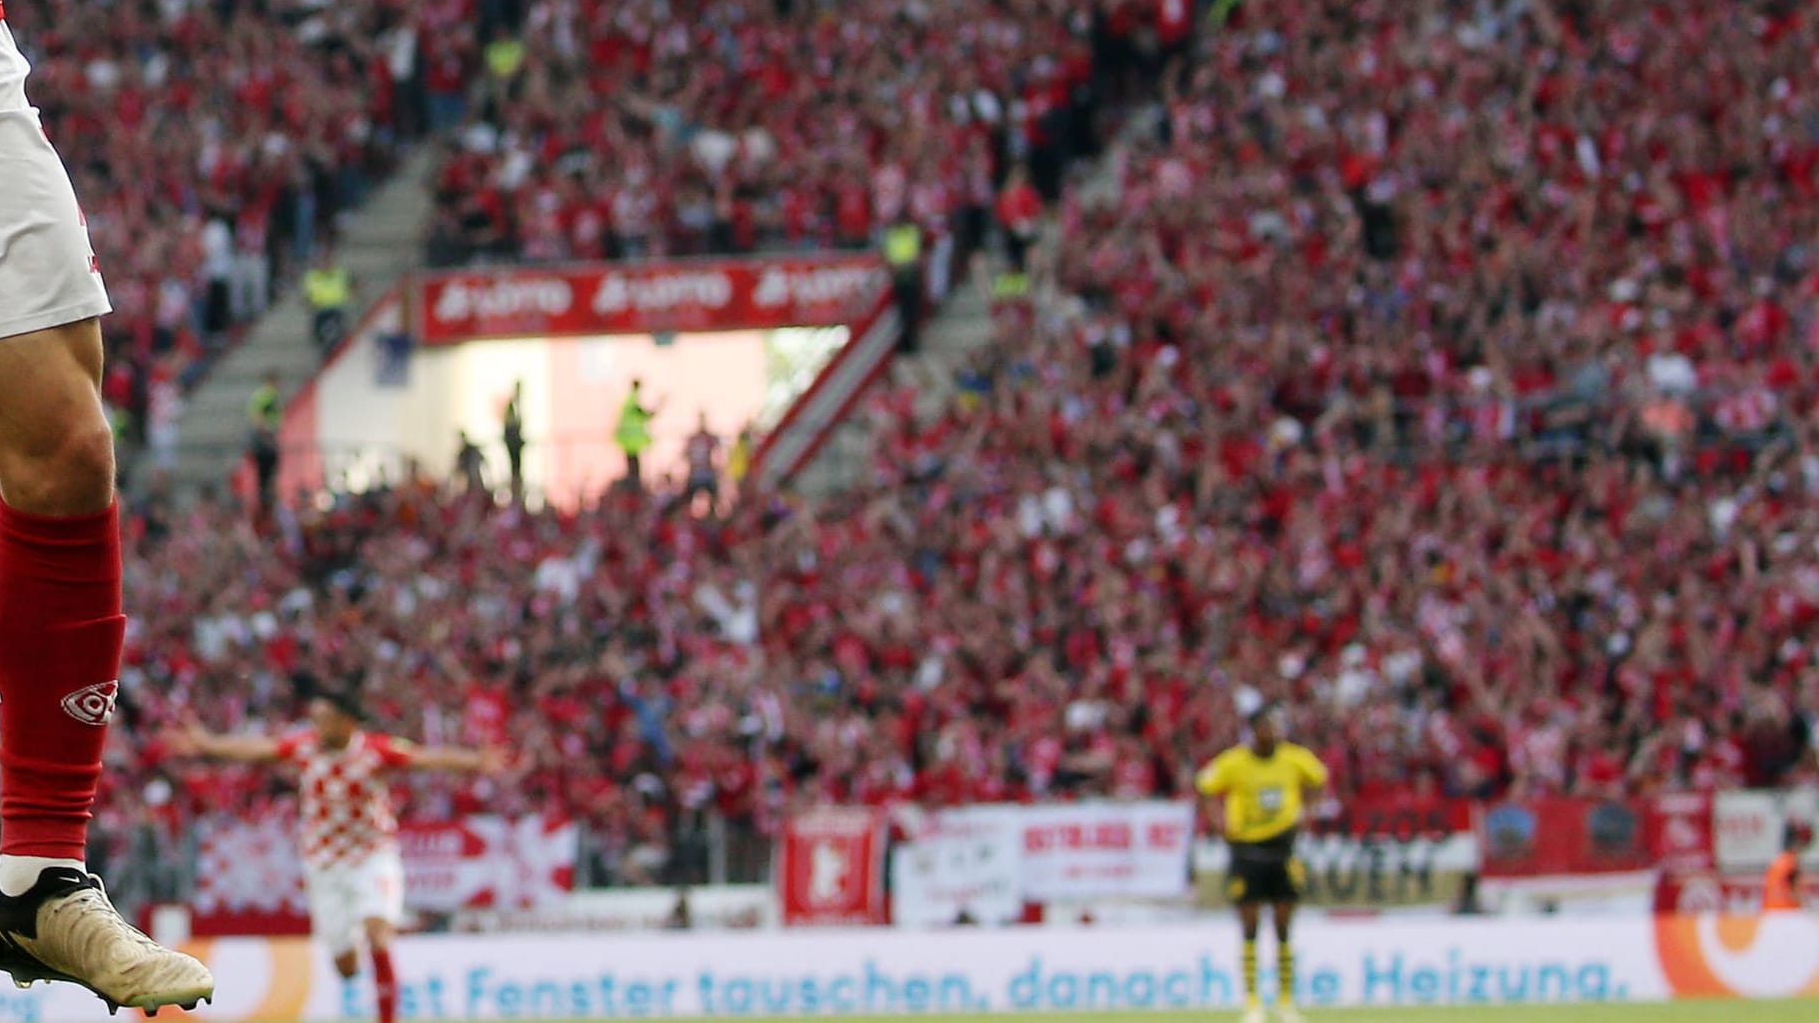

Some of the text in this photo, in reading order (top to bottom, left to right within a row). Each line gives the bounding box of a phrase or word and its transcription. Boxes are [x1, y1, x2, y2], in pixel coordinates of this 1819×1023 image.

[340, 974, 444, 1019] Est
[466, 965, 676, 1018] Fenster
[698, 953, 992, 1014] tauschen,
[1007, 949, 1234, 1009] danach
[1362, 949, 1630, 1005] Heizung.
